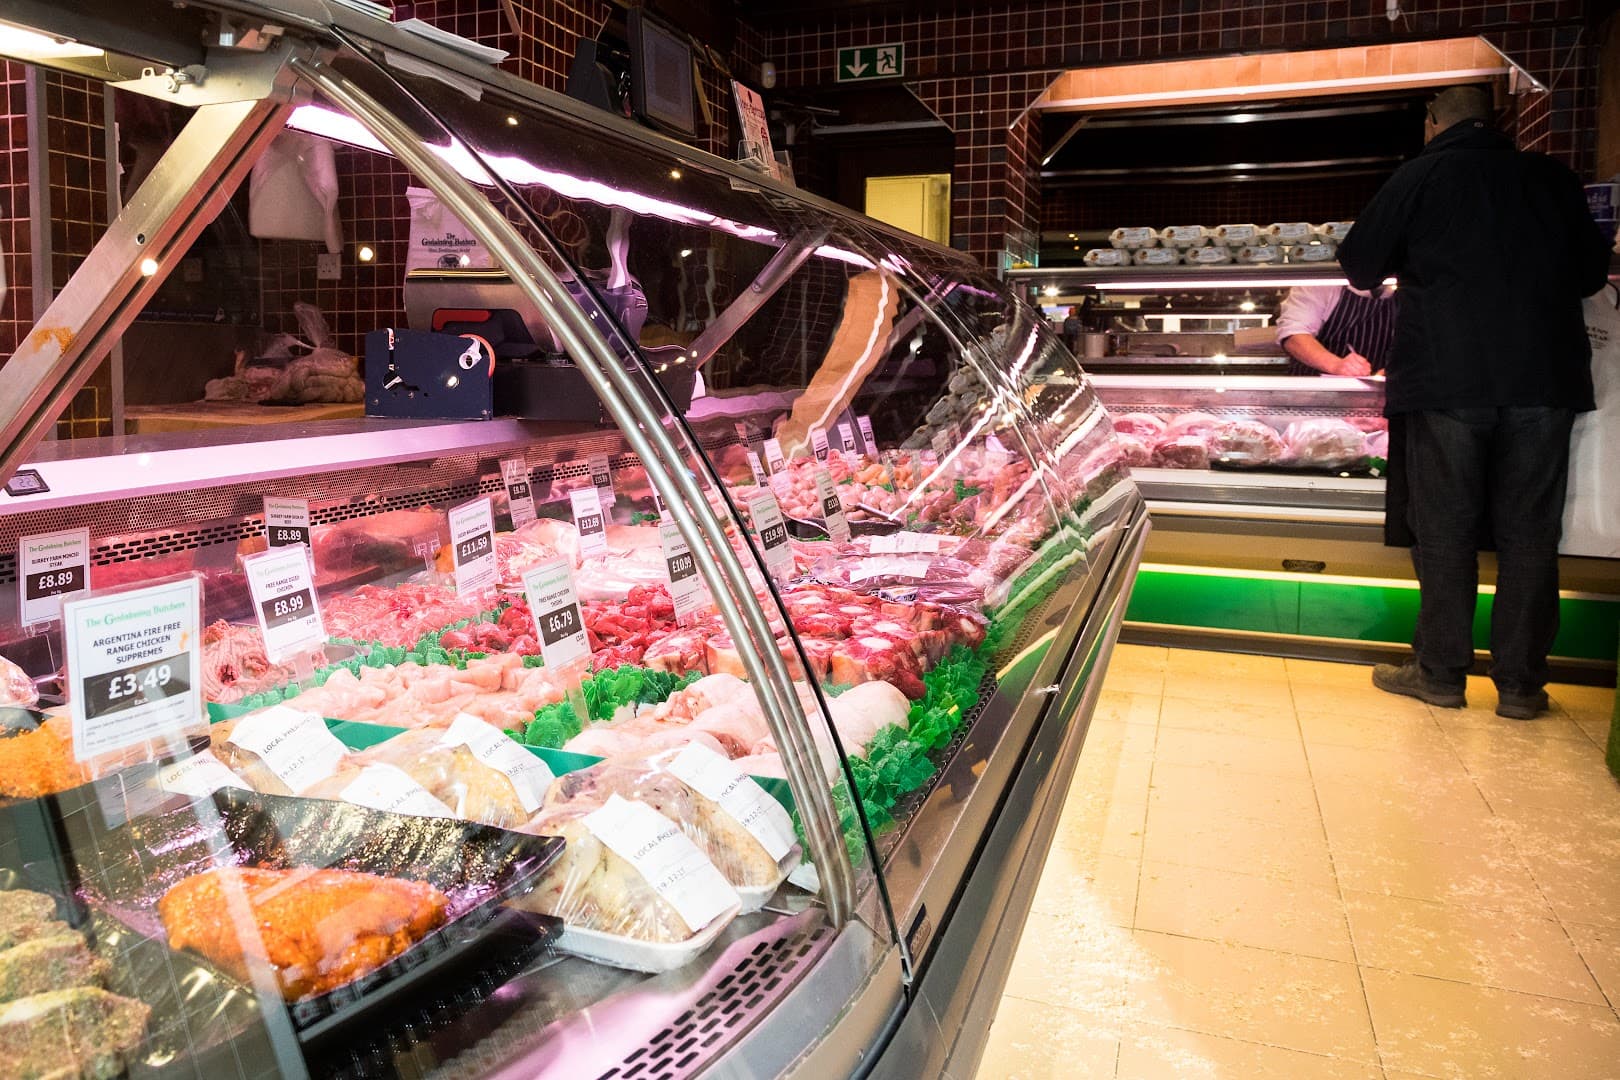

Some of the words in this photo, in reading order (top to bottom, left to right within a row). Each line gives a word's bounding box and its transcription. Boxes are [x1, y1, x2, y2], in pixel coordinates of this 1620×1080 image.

[278, 530, 302, 540] £8.89
[765, 526, 784, 543] £19.99
[462, 536, 487, 557] £11.59
[672, 556, 692, 573] £10.99
[38, 571, 73, 590] £8.89
[274, 595, 303, 616] £8.99
[86, 618, 101, 628] The
[549, 610, 572, 632] £6.79
[93, 631, 142, 648] ARGENTINA
[143, 626, 161, 636] FIRE
[163, 622, 181, 631] FREE
[106, 644, 134, 655] RANGE
[136, 635, 171, 648] CHICKEN
[116, 647, 163, 664] SUPPREMES
[109, 665, 171, 700] £3.49
[263, 737, 283, 754] LOCAL
[633, 840, 658, 860] LOCAL
